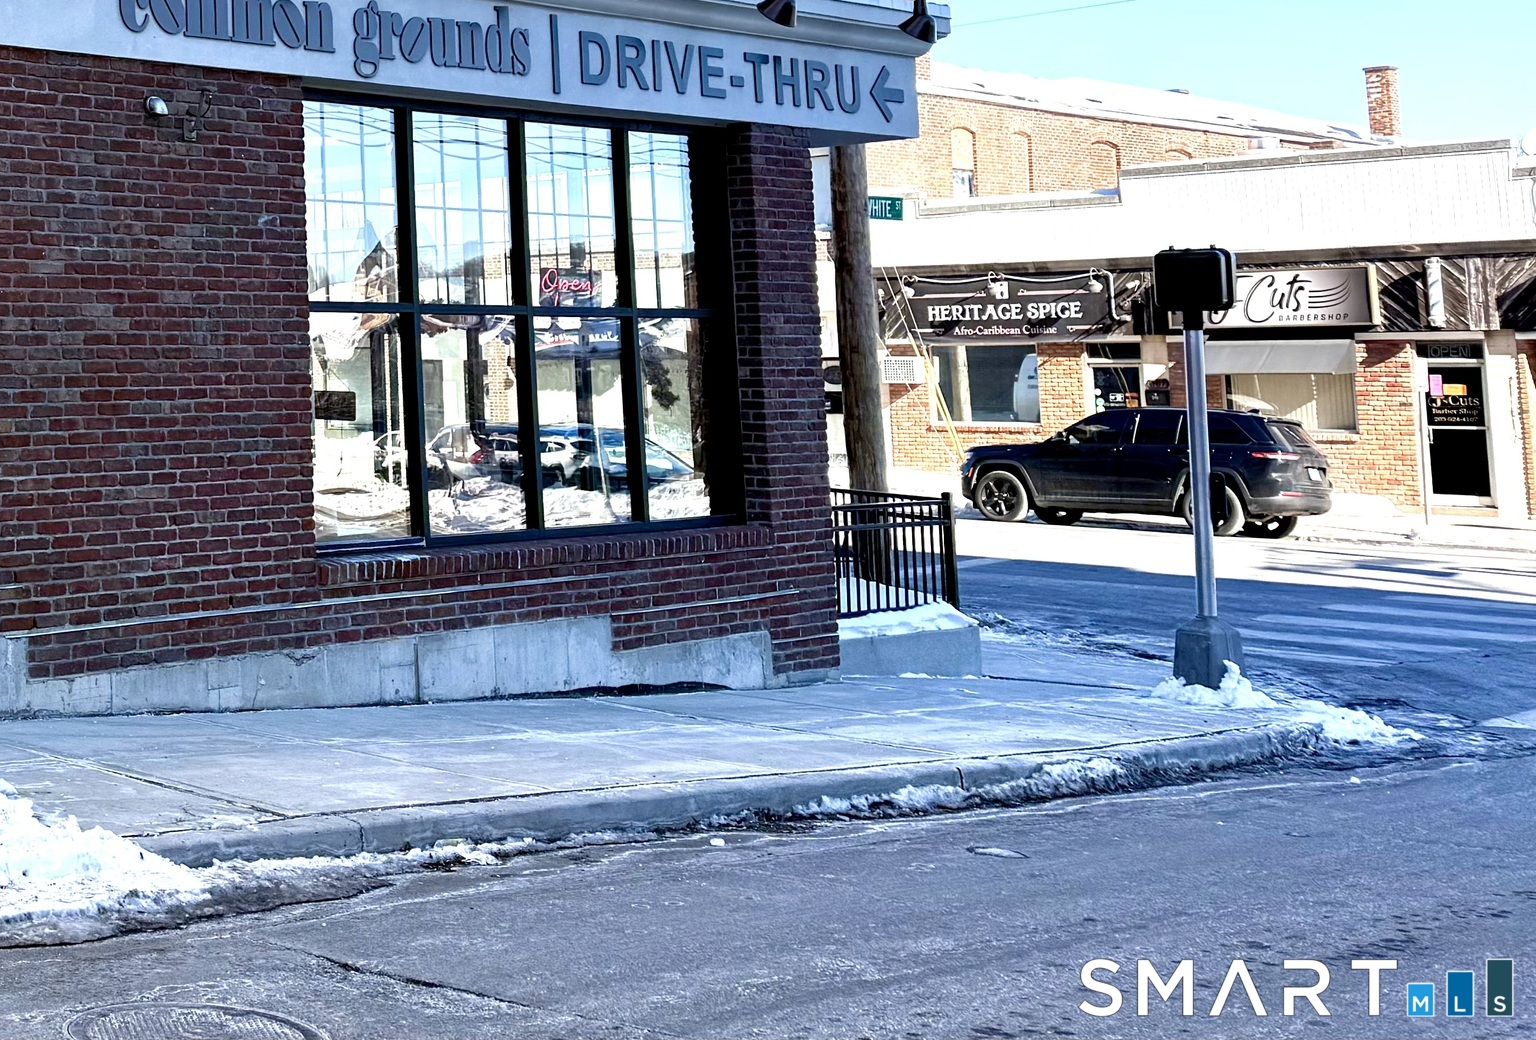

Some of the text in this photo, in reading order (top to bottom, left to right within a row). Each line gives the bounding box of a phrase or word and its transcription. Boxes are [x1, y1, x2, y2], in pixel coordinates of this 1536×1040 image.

[353, 0, 531, 78] grounds
[579, 30, 861, 114] DRIVE-THRU
[541, 268, 602, 307] Open
[1244, 274, 1312, 323] Cuts
[927, 301, 1083, 322] HERITAGE SPICE
[1279, 313, 1349, 322] BARBERSHOP
[954, 324, 1057, 336] Afro-Caribbean Cuisine
[1430, 346, 1468, 358] OPEN
